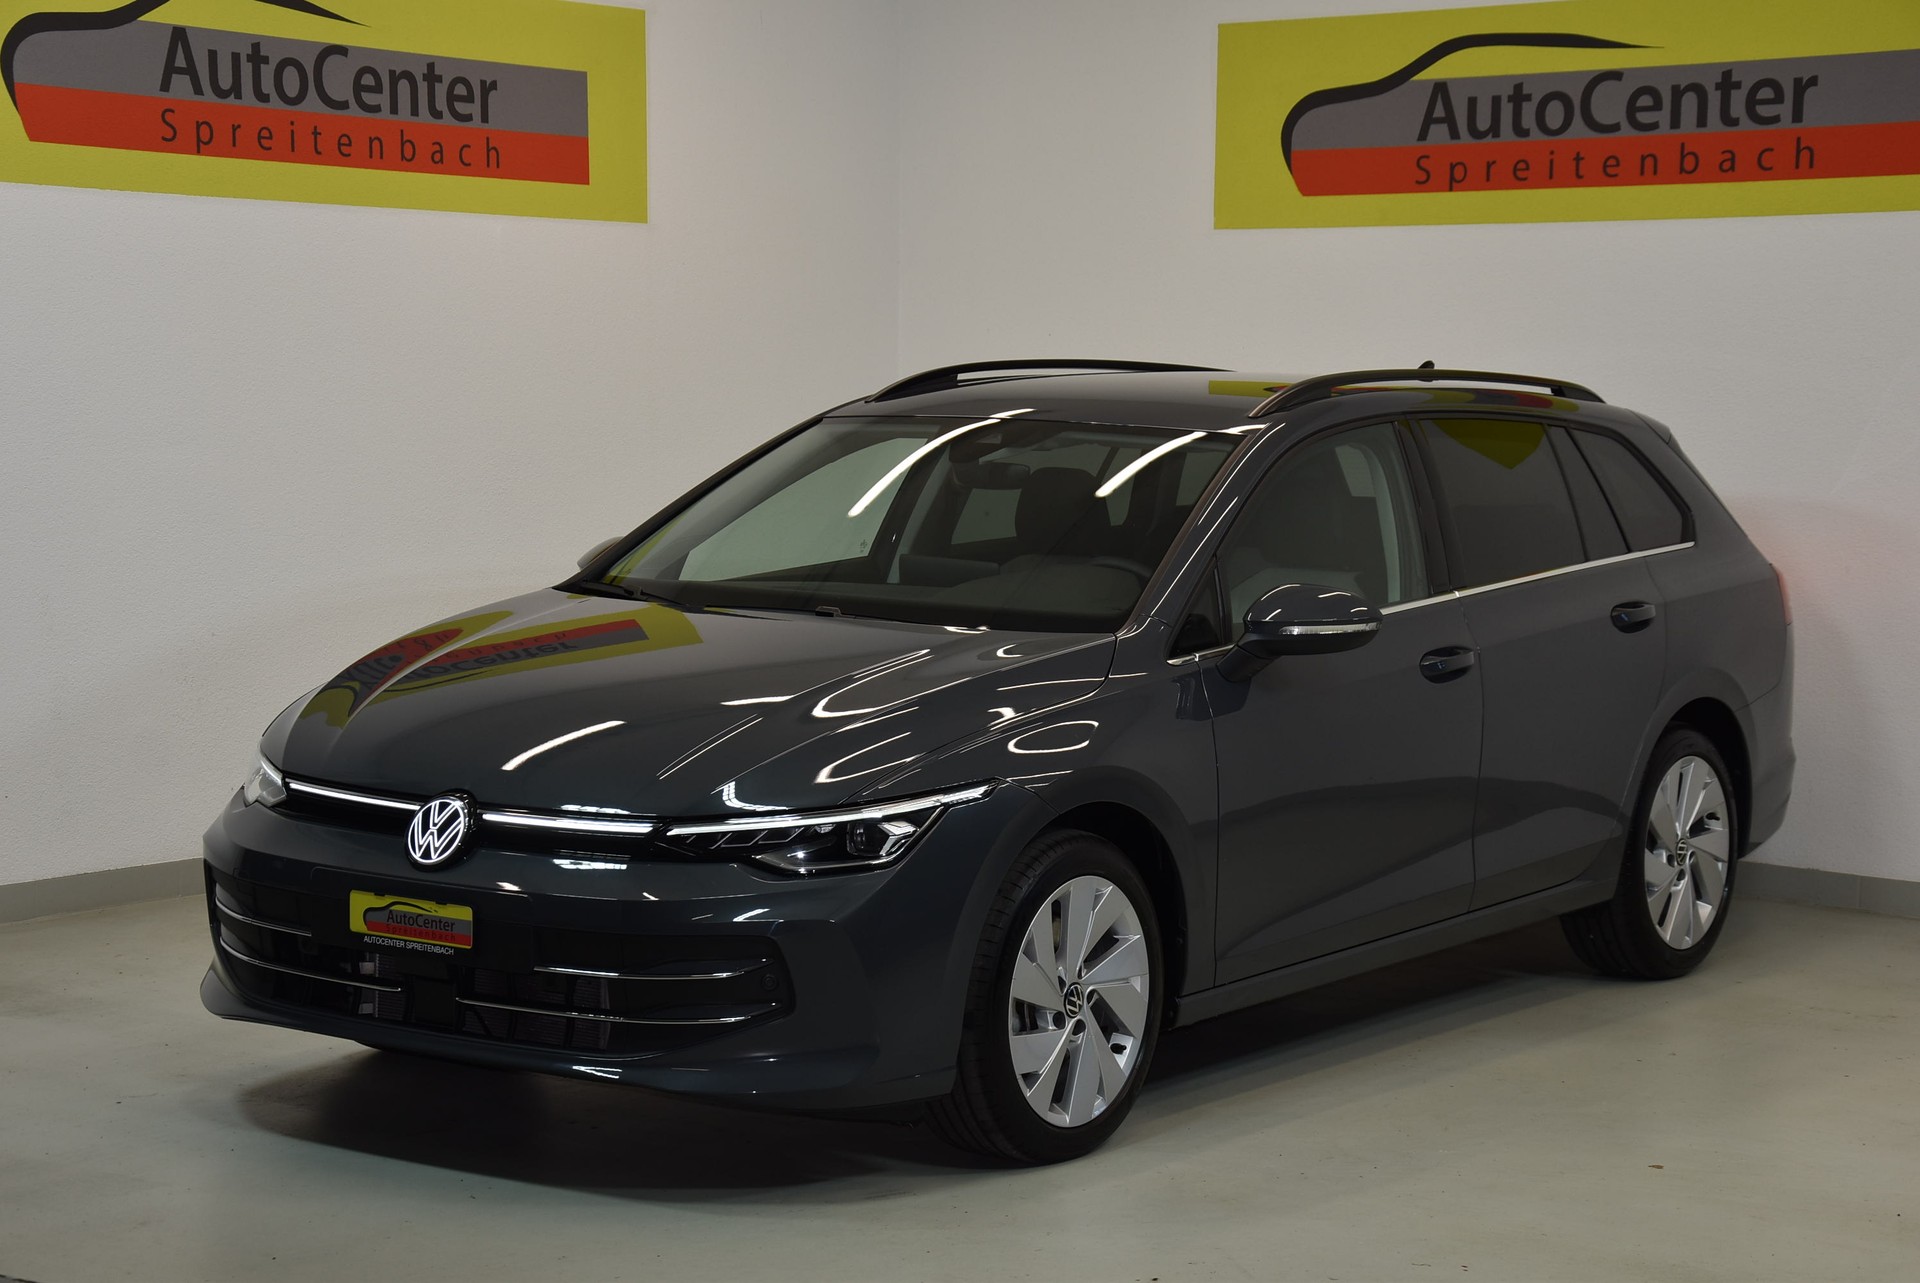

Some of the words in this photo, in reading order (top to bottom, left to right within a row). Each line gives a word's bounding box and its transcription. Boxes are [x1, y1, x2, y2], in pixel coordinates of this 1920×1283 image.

[159, 26, 497, 124] AutoCenter
[1416, 68, 1819, 142] AutoCenter
[160, 107, 501, 170] Spreitenbach
[1415, 136, 1816, 191] Spreitenbach
[363, 935, 405, 948] AUTOCENTER
[405, 941, 455, 956] SPREITENBACH
[386, 910, 456, 932] AutoCenter
